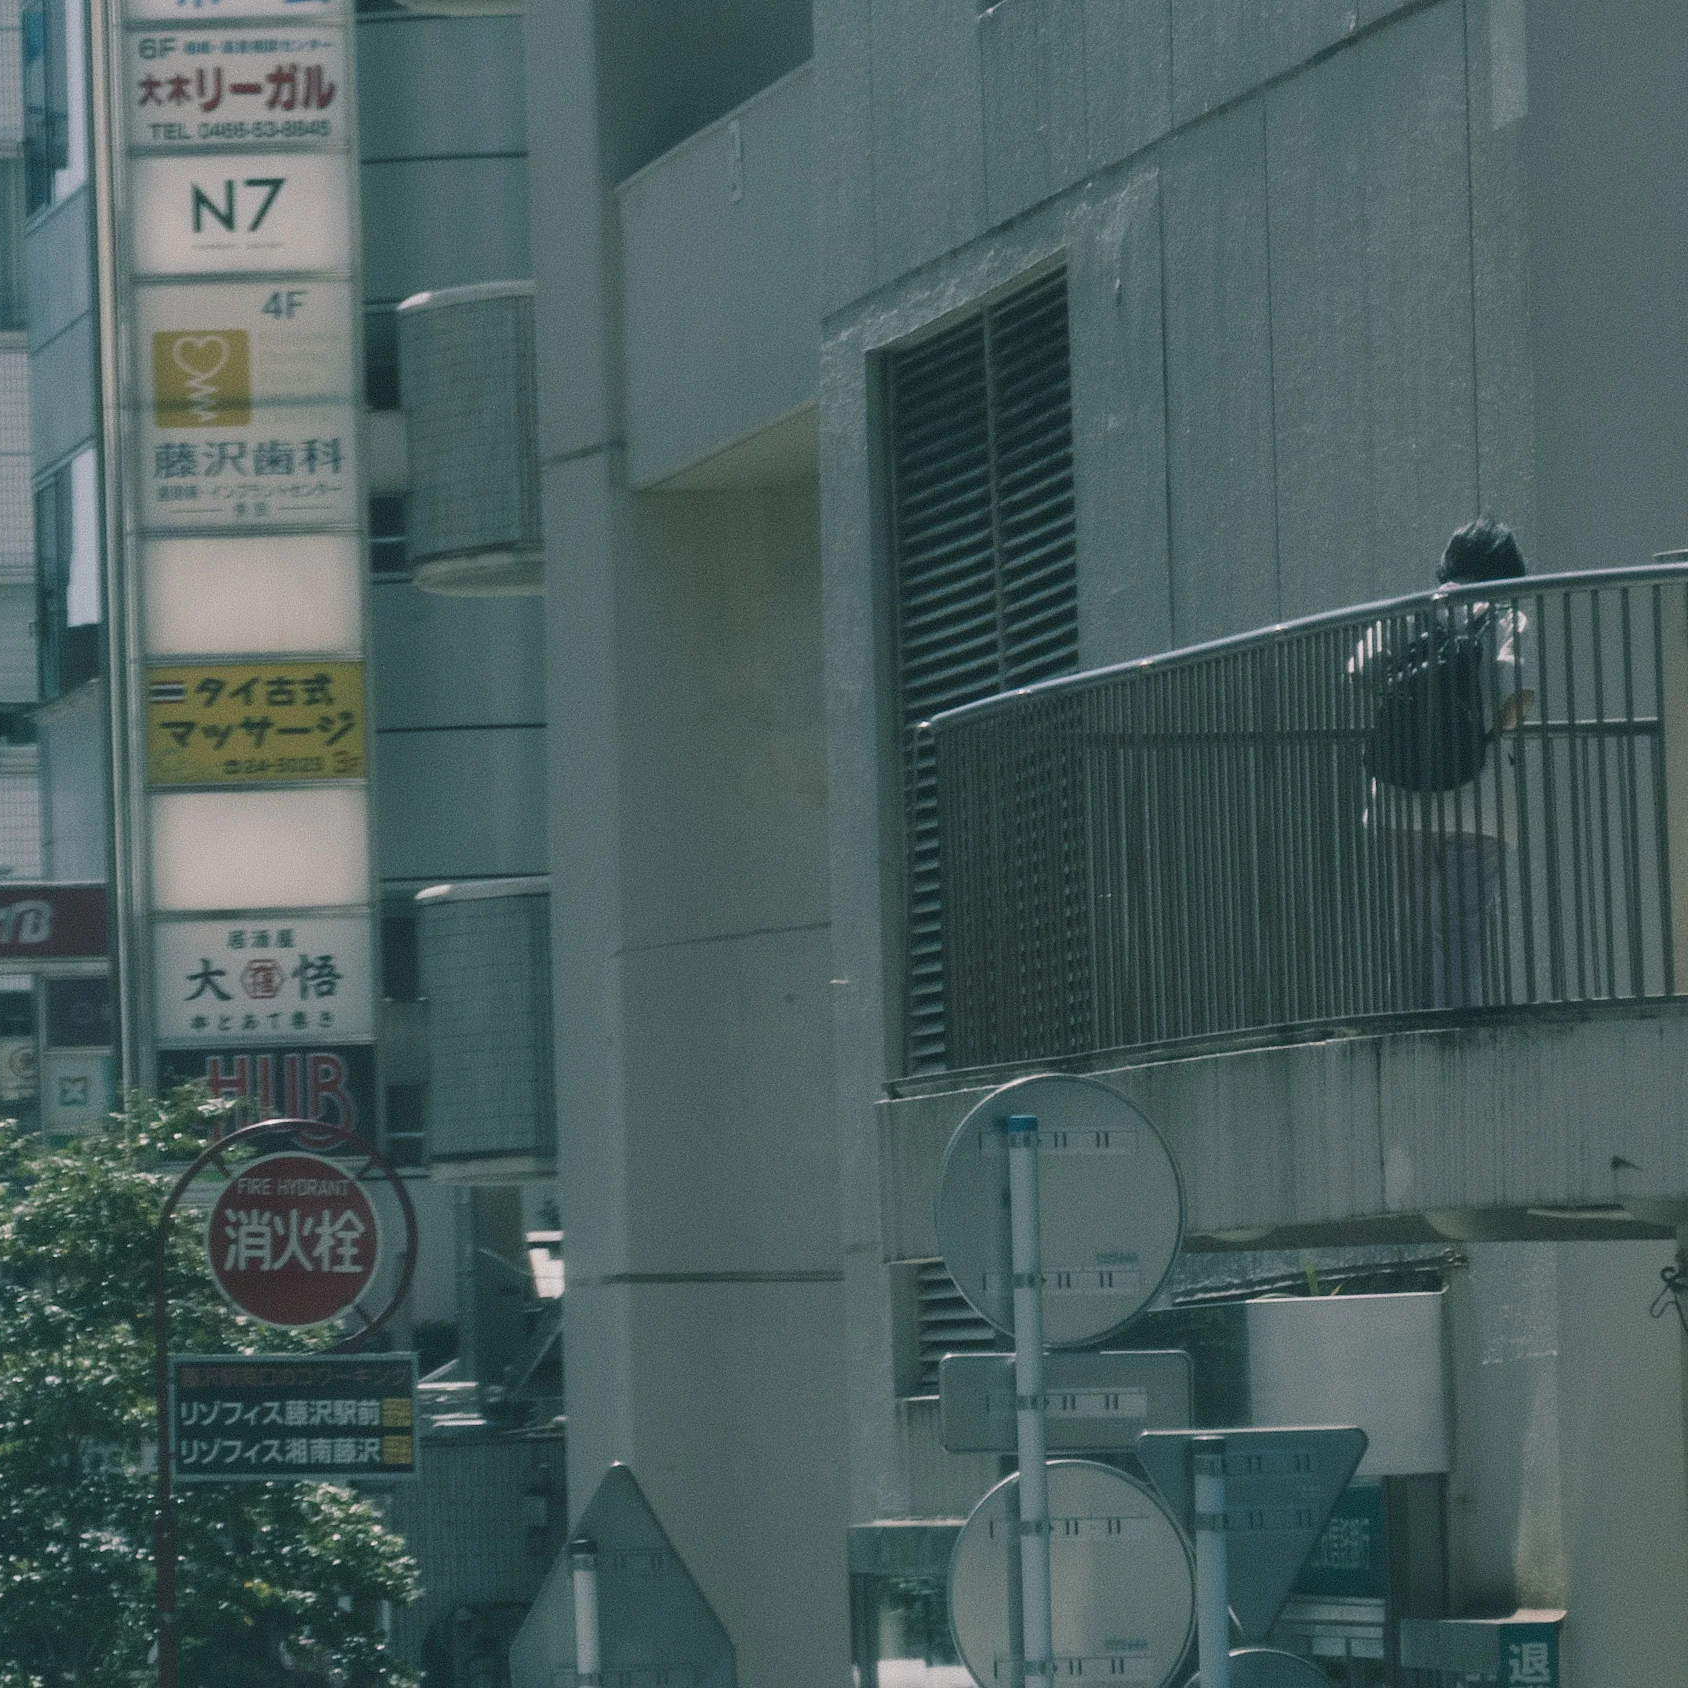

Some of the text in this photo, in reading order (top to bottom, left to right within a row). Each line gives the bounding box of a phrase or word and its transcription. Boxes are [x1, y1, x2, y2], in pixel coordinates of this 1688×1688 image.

[138, 36, 178, 60] 6F
[137, 62, 337, 112] 大木リーガル
[149, 122, 192, 141] TEL
[191, 177, 288, 233] N7
[261, 290, 308, 320] 4F
[154, 438, 346, 479] 藤沢歯科
[195, 672, 336, 708] タイ古式
[159, 711, 357, 750] マッサージ
[205, 1050, 357, 1152] HUB
[237, 1178, 352, 1197] FIRE HYDRANT
[222, 1207, 366, 1274] 消火栓
